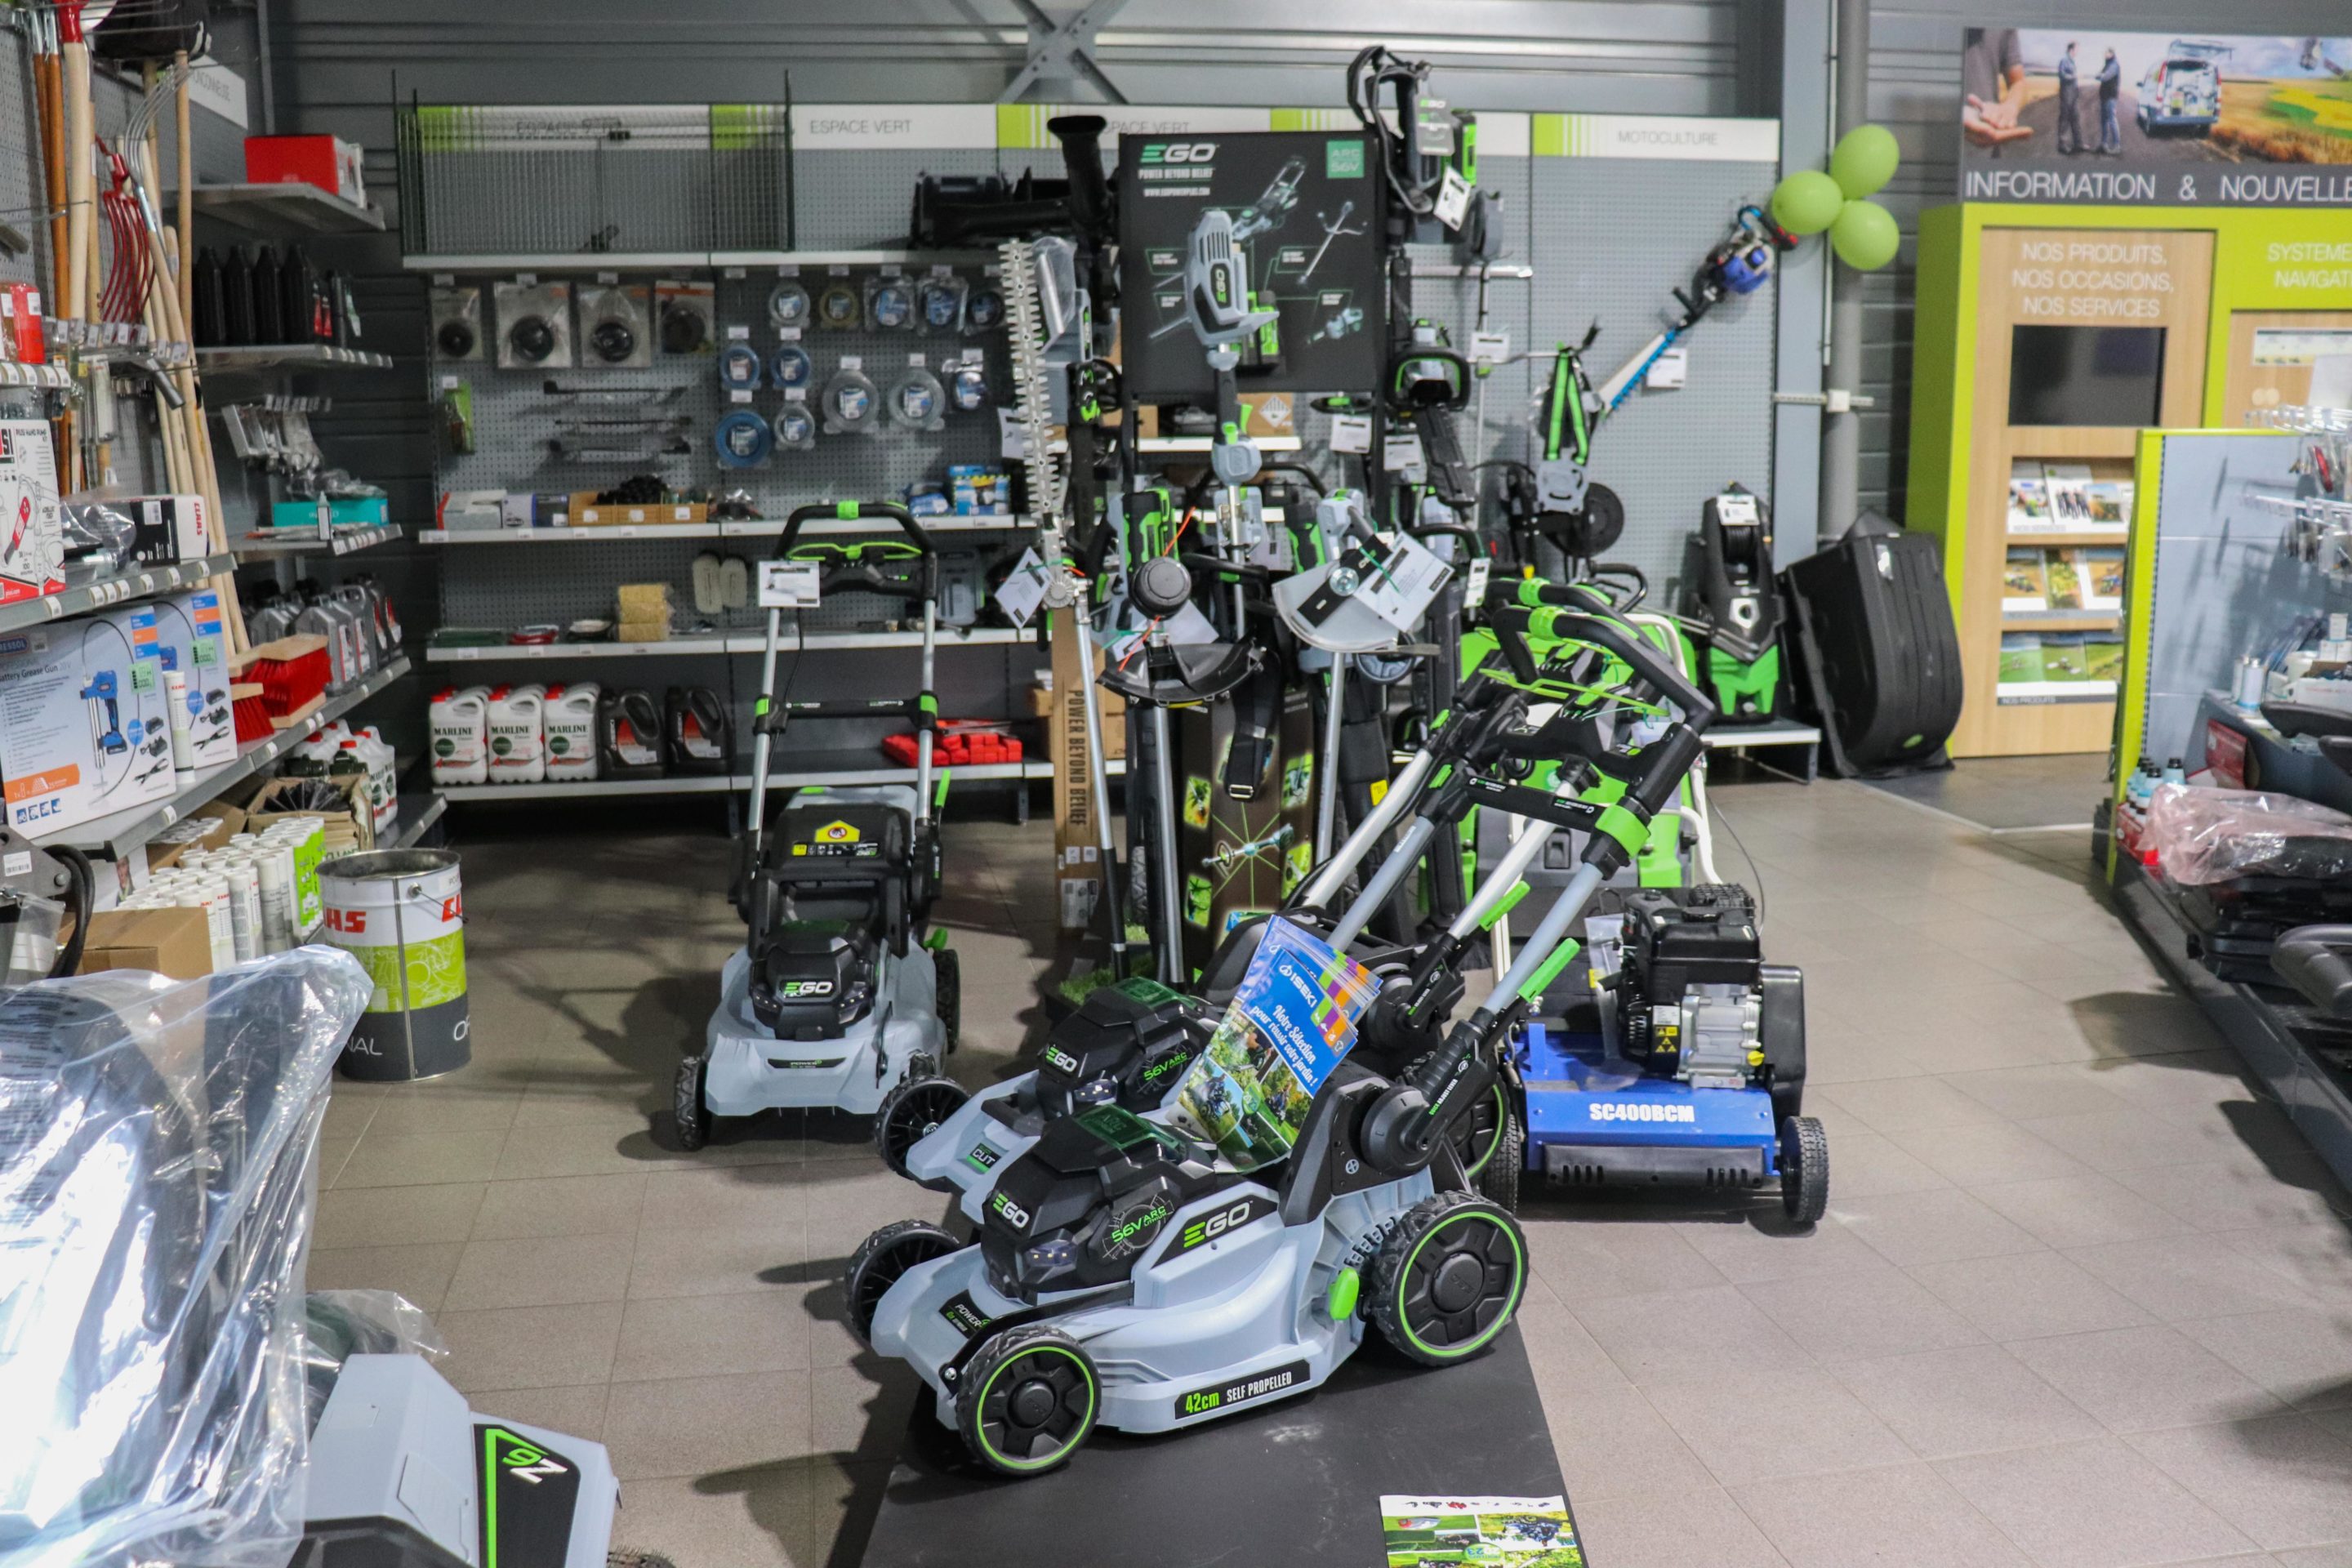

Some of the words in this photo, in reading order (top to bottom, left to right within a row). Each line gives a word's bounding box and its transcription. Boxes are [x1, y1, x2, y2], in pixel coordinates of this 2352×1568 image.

[810, 120, 867, 133] ESPACE
[872, 120, 913, 133] VERT
[1618, 130, 1718, 145] MOTOCULTURE
[1140, 144, 1217, 163] EGO
[1965, 171, 2155, 200] INFORMATION
[2180, 174, 2198, 201] &
[2219, 174, 2352, 203] NOUVELLE
[2021, 243, 2064, 263] NOS
[2069, 244, 2167, 266] PRODUITS,
[1215, 269, 1227, 303] EGO
[2011, 269, 2053, 290] NOS
[2060, 270, 2174, 293] OCCASIONS,
[2022, 296, 2065, 316] NOS
[2069, 297, 2160, 318] SERVICES
[194, 502, 203, 536] CLAAS
[21, 667, 43, 678] Grease
[44, 665, 58, 673] Gun
[1068, 690, 1085, 733] POWER
[434, 727, 474, 736] MARLINE
[491, 725, 530, 735] MARLINE
[548, 724, 588, 734] MARLINE
[1069, 737, 1086, 784] BEYOND
[1070, 788, 1087, 826] BELIEF
[784, 982, 833, 994] EGO
[1290, 973, 1317, 1008] ISEKI
[1250, 1006, 1271, 1024] pour
[1268, 1022, 1288, 1046] réussir
[1284, 1045, 1298, 1062] votre
[1292, 1058, 1314, 1083] jardin
[1272, 1004, 1291, 1031] Notre
[1289, 1027, 1316, 1064] Sélection
[1045, 1045, 1077, 1072] EGO
[1143, 1059, 1169, 1081] 56V
[1168, 1052, 1188, 1066] ARC
[1437, 1087, 1450, 1104] ADJUST
[1448, 1078, 1459, 1093] LEVER
[1588, 1102, 1695, 1123] SC400BCM
[973, 1149, 996, 1165] CUT
[993, 1192, 1029, 1228] EGO
[1143, 1210, 1168, 1227] LITHIUM
[1111, 1215, 1145, 1243] 56V
[1143, 1205, 1167, 1223] ARC
[1183, 1202, 1250, 1249] EGO
[955, 1303, 982, 1328] POWER
[1185, 1391, 1220, 1414] 42cm
[1227, 1385, 1245, 1403] SELF
[1248, 1371, 1292, 1397] PROPELLED
